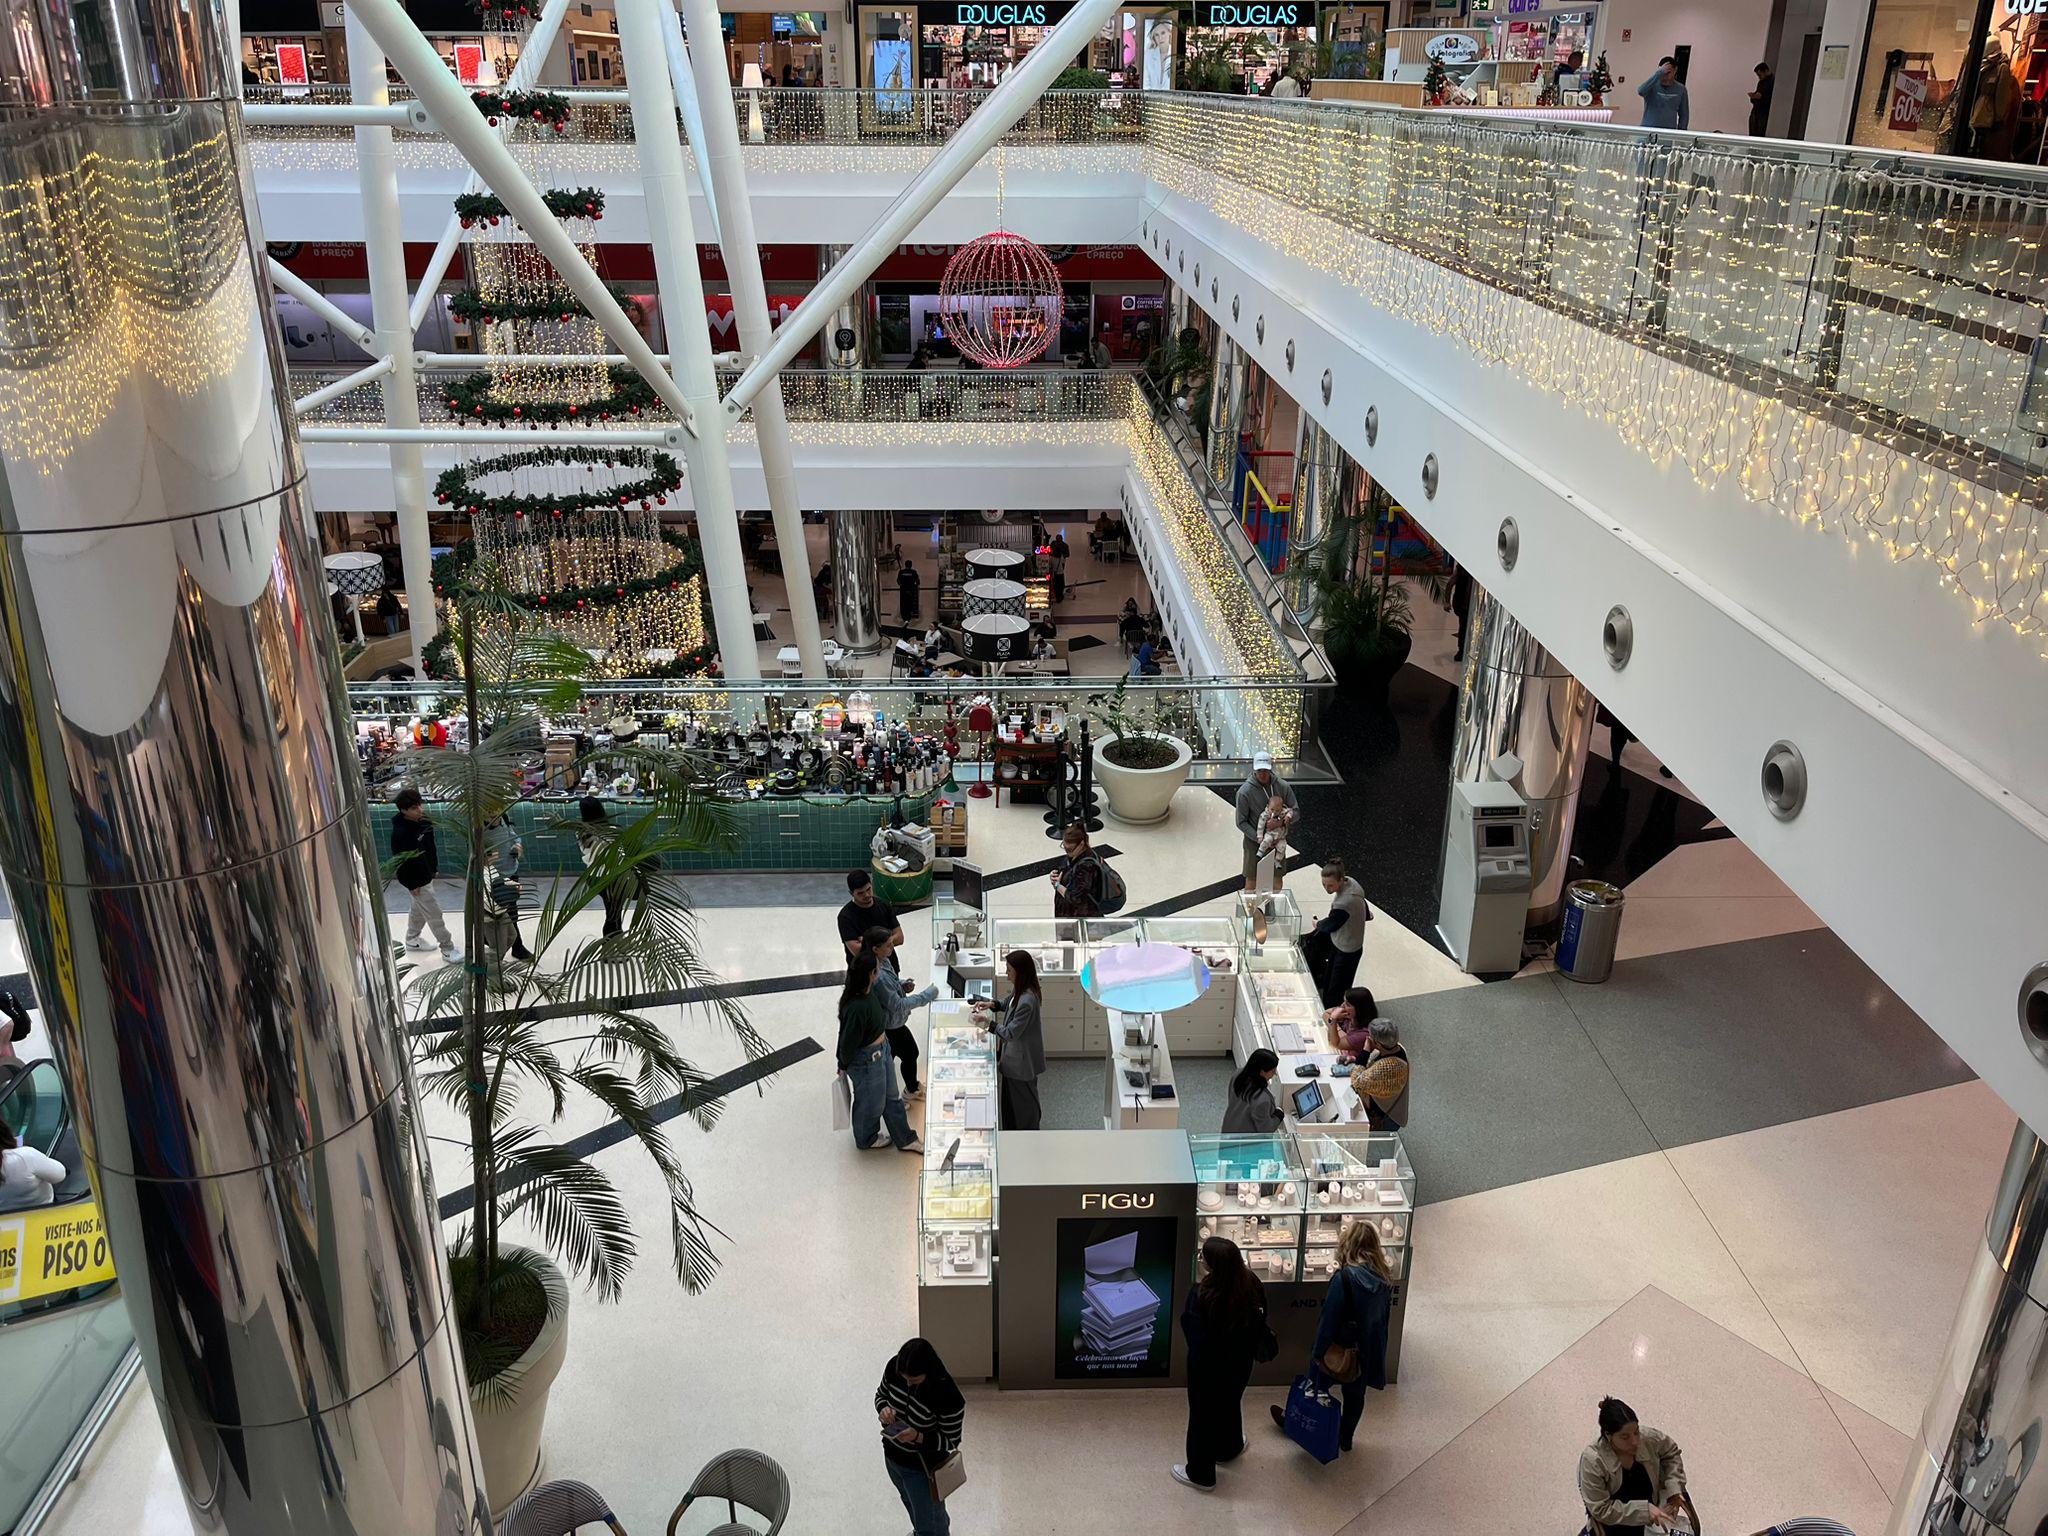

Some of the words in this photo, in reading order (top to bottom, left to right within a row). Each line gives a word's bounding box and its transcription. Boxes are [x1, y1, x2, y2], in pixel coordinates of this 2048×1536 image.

[957, 4, 1046, 25] DOUGLAS
[1210, 4, 1298, 25] DOUGLAS
[1904, 78, 1919, 95] TUDO
[321, 248, 354, 259] PREÇO
[1093, 250, 1124, 261] PREÇO
[1081, 1192, 1155, 1210] FIGU
[45, 1219, 93, 1241] VISITE-NOS
[96, 1217, 103, 1232] N
[43, 1239, 88, 1280] PISO
[1290, 1298, 1317, 1308] AND
